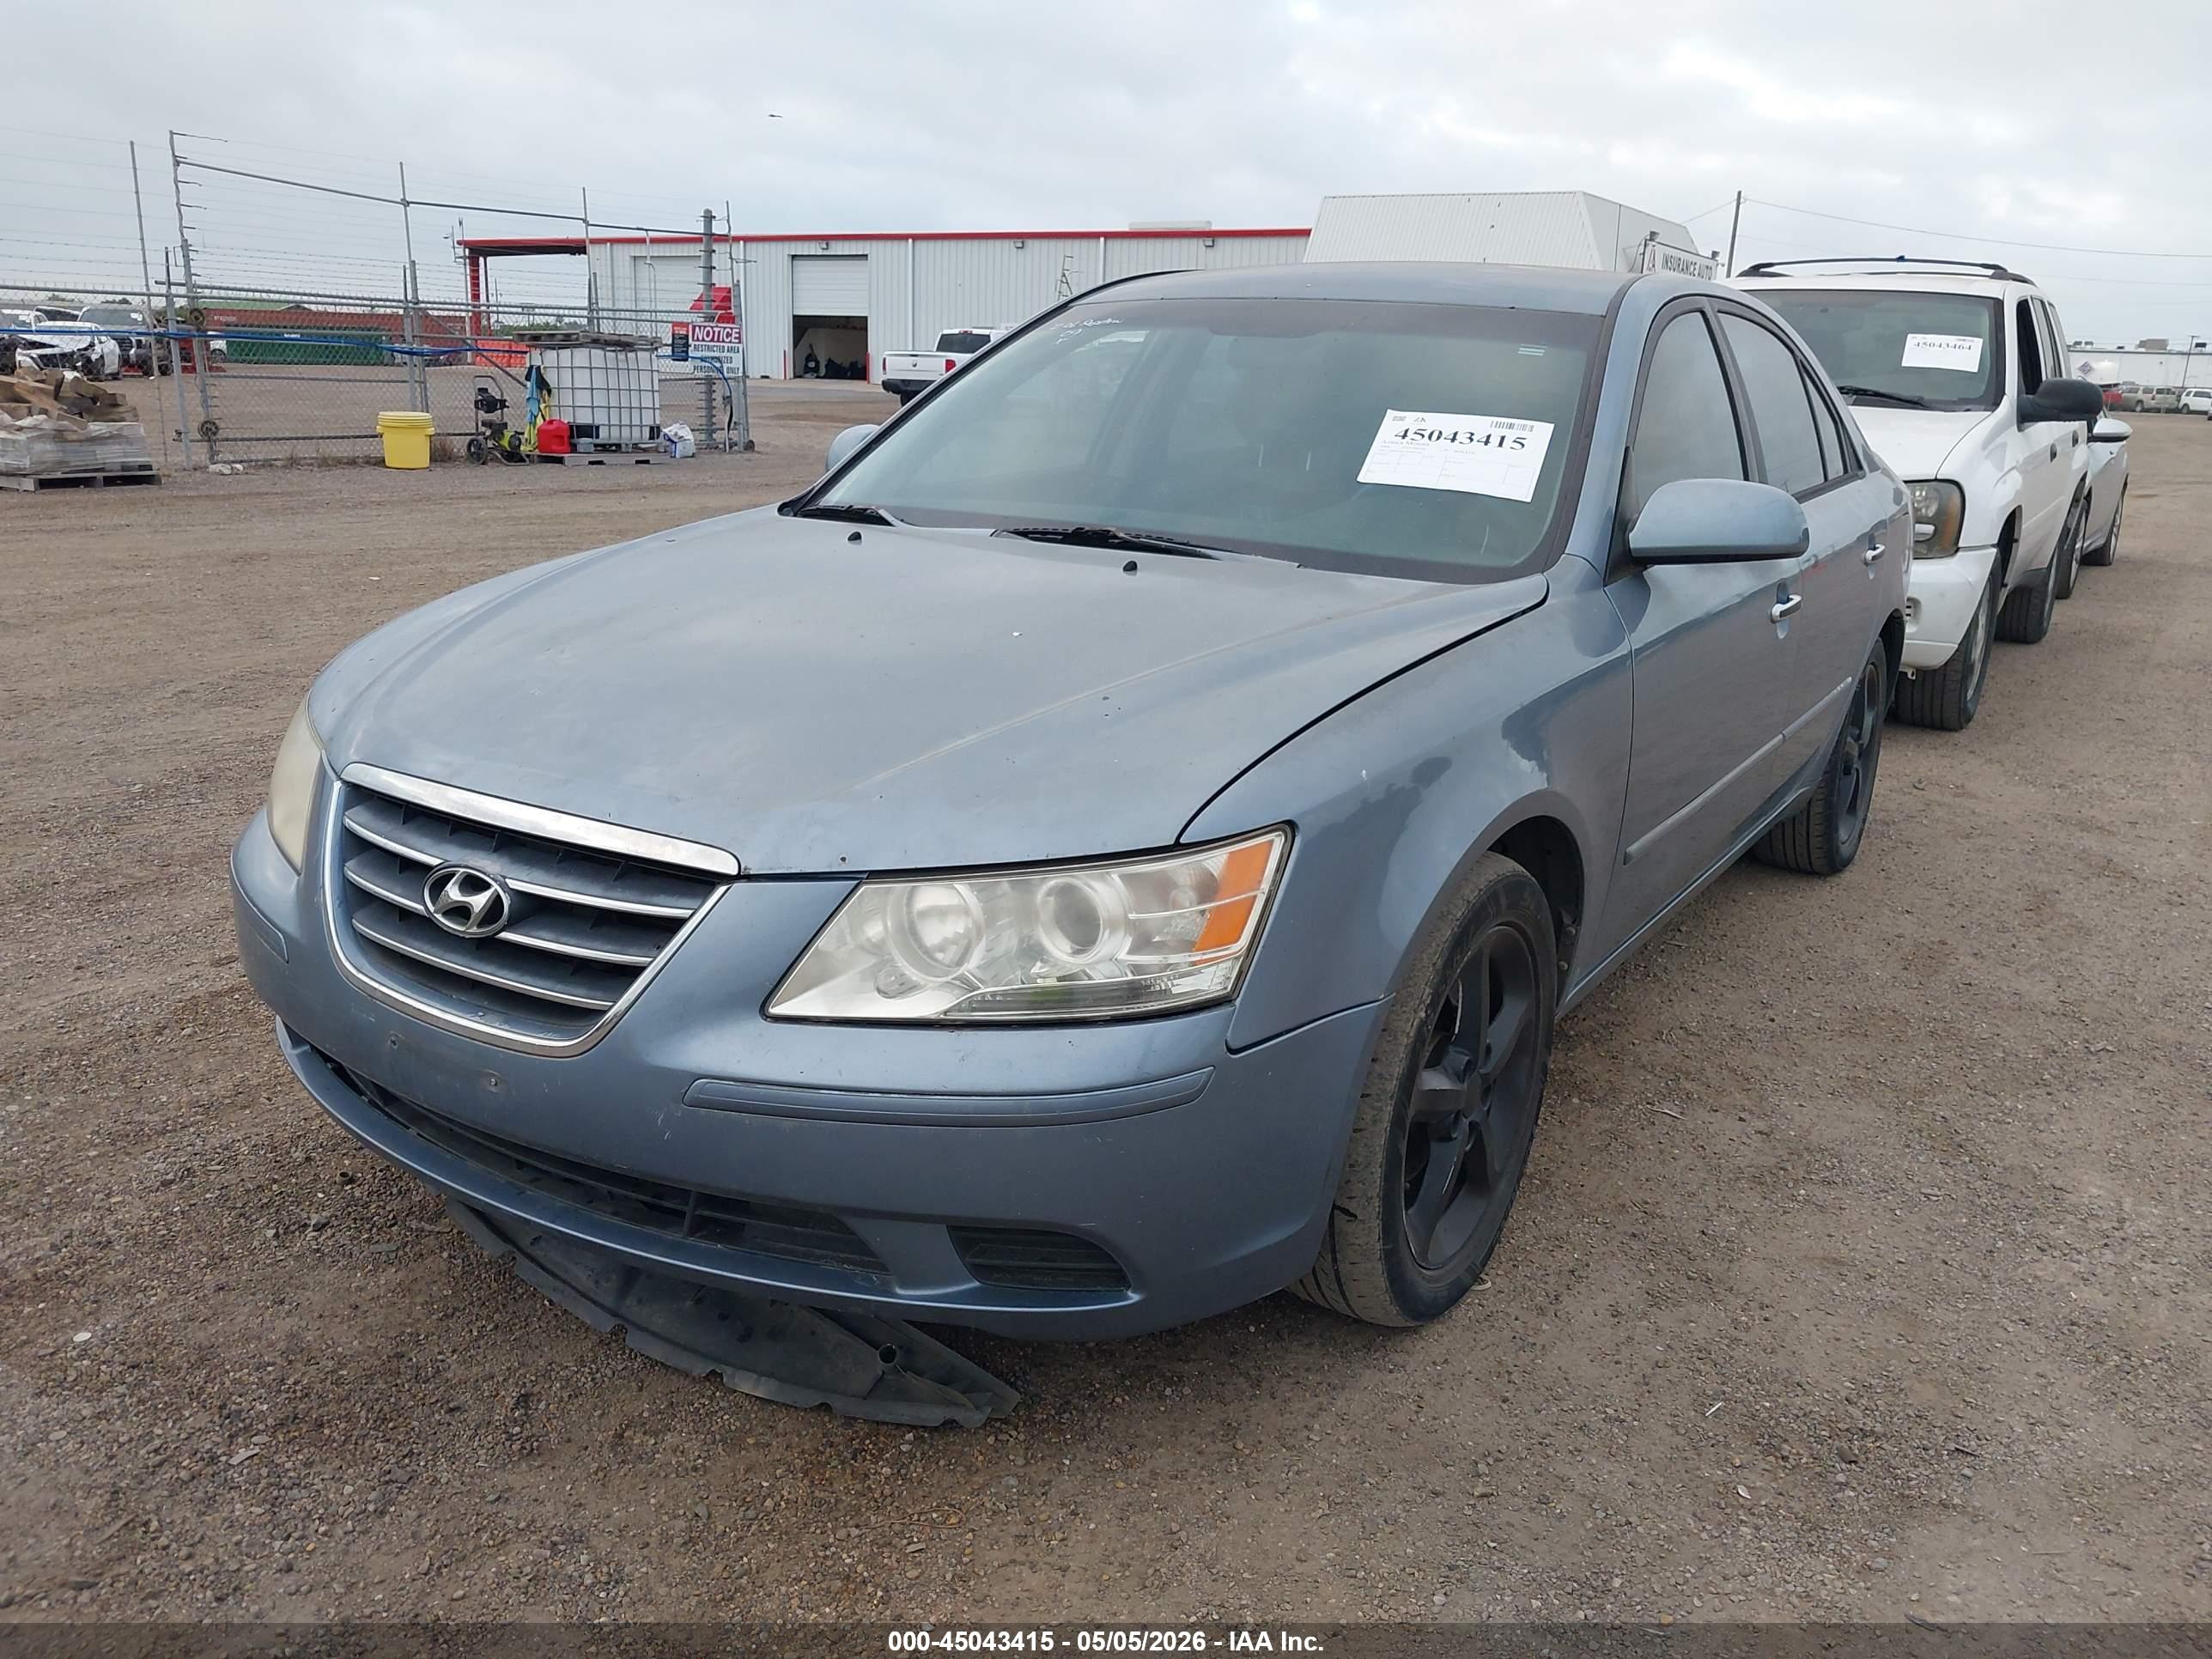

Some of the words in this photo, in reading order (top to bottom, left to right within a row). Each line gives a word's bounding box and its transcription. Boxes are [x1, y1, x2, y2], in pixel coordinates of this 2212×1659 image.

[1662, 253, 1697, 277] INSURANCE
[1697, 263, 1712, 281] AUTO
[694, 326, 739, 343] NOTICE
[693, 343, 726, 354] RESTRICTED
[726, 345, 740, 354] AREA
[726, 366, 740, 374] ONLY
[1395, 427, 1528, 451] 45043415
